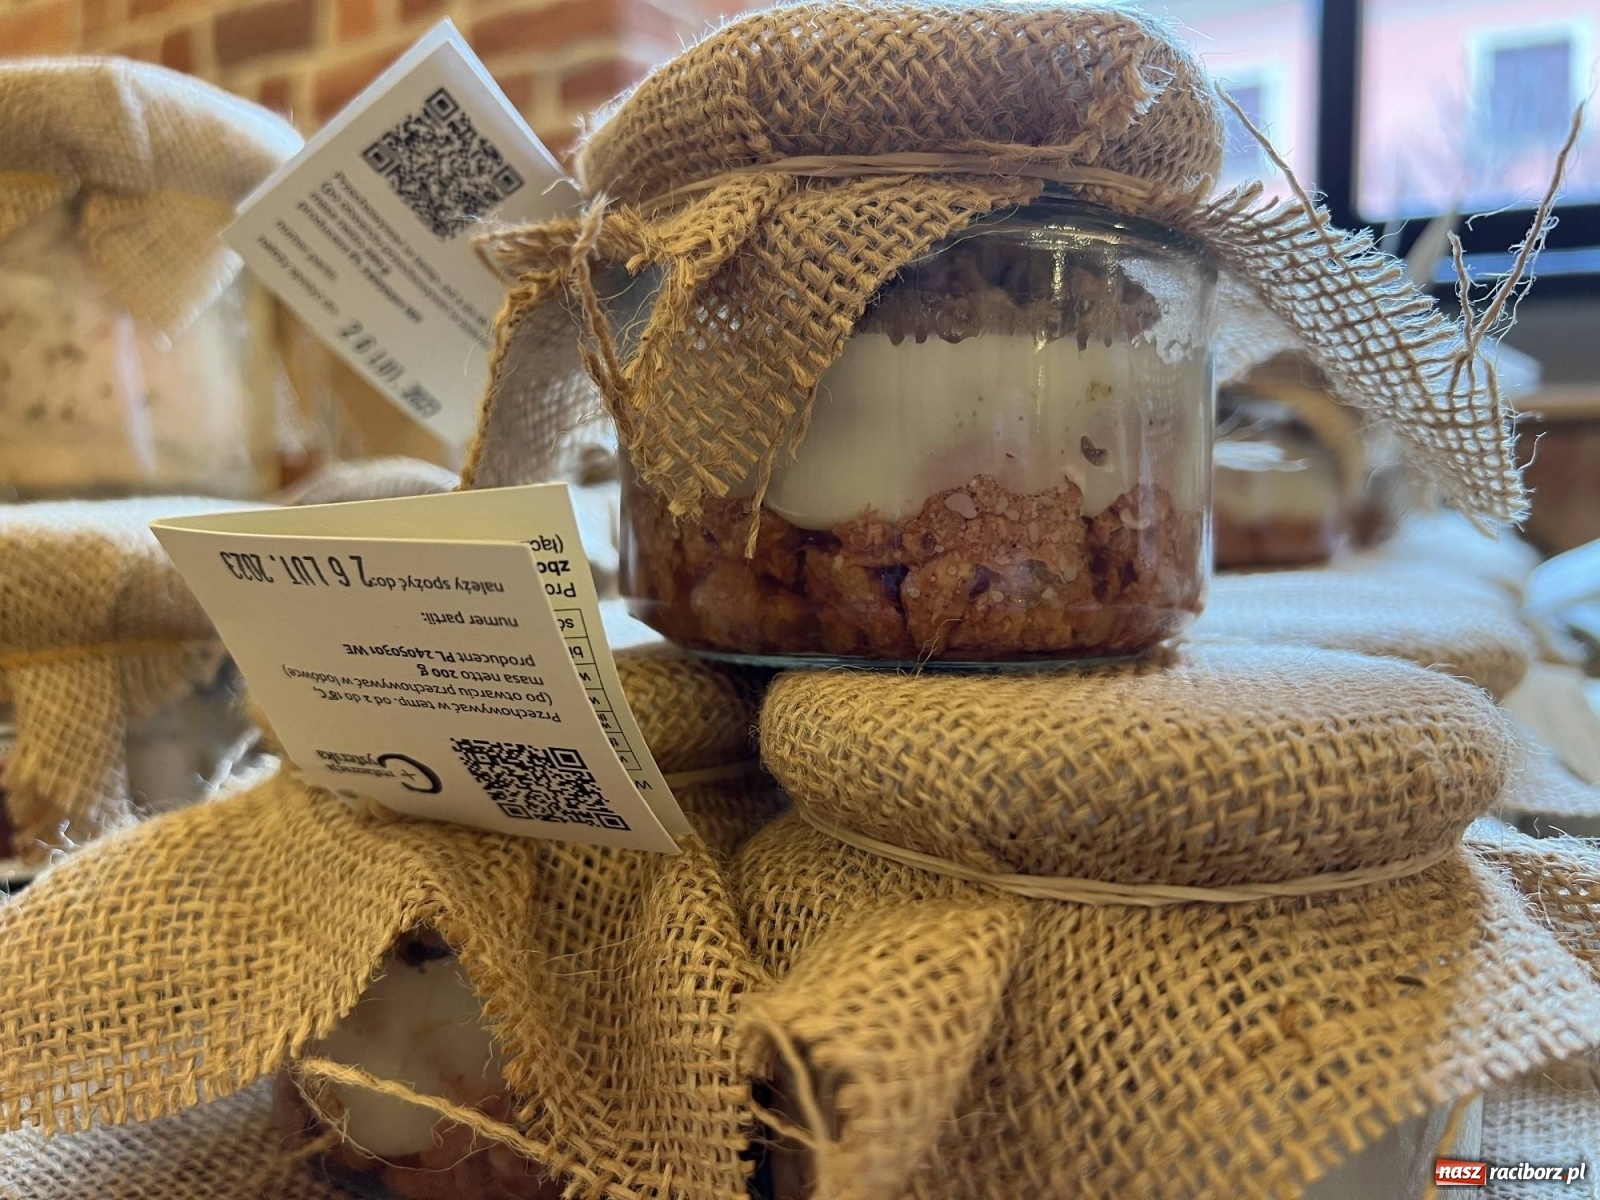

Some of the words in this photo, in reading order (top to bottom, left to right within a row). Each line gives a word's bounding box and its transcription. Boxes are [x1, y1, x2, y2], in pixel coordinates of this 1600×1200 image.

[219, 551, 274, 583] 2023
[399, 575, 451, 592] spożyć
[456, 576, 505, 595] należy
[421, 611, 465, 625] partii:
[470, 614, 519, 627] numer
[342, 644, 369, 656] WE
[369, 644, 434, 660] 24050301
[435, 650, 456, 663] PL
[456, 652, 536, 667] producent
[282, 664, 341, 686] lodówce)
[416, 663, 429, 676] g
[431, 668, 458, 679] 200
[341, 677, 354, 685] w
[460, 670, 501, 683] netto
[504, 674, 545, 685] masa
[354, 678, 456, 695] przechowywać
[345, 692, 361, 703] do
[363, 694, 373, 703] 2
[374, 695, 392, 706] od
[457, 687, 523, 701] otwarciu
[526, 691, 553, 706] (po
[393, 696, 435, 710] temp.
[438, 701, 452, 710] w
[452, 703, 561, 723] Przechowywać
